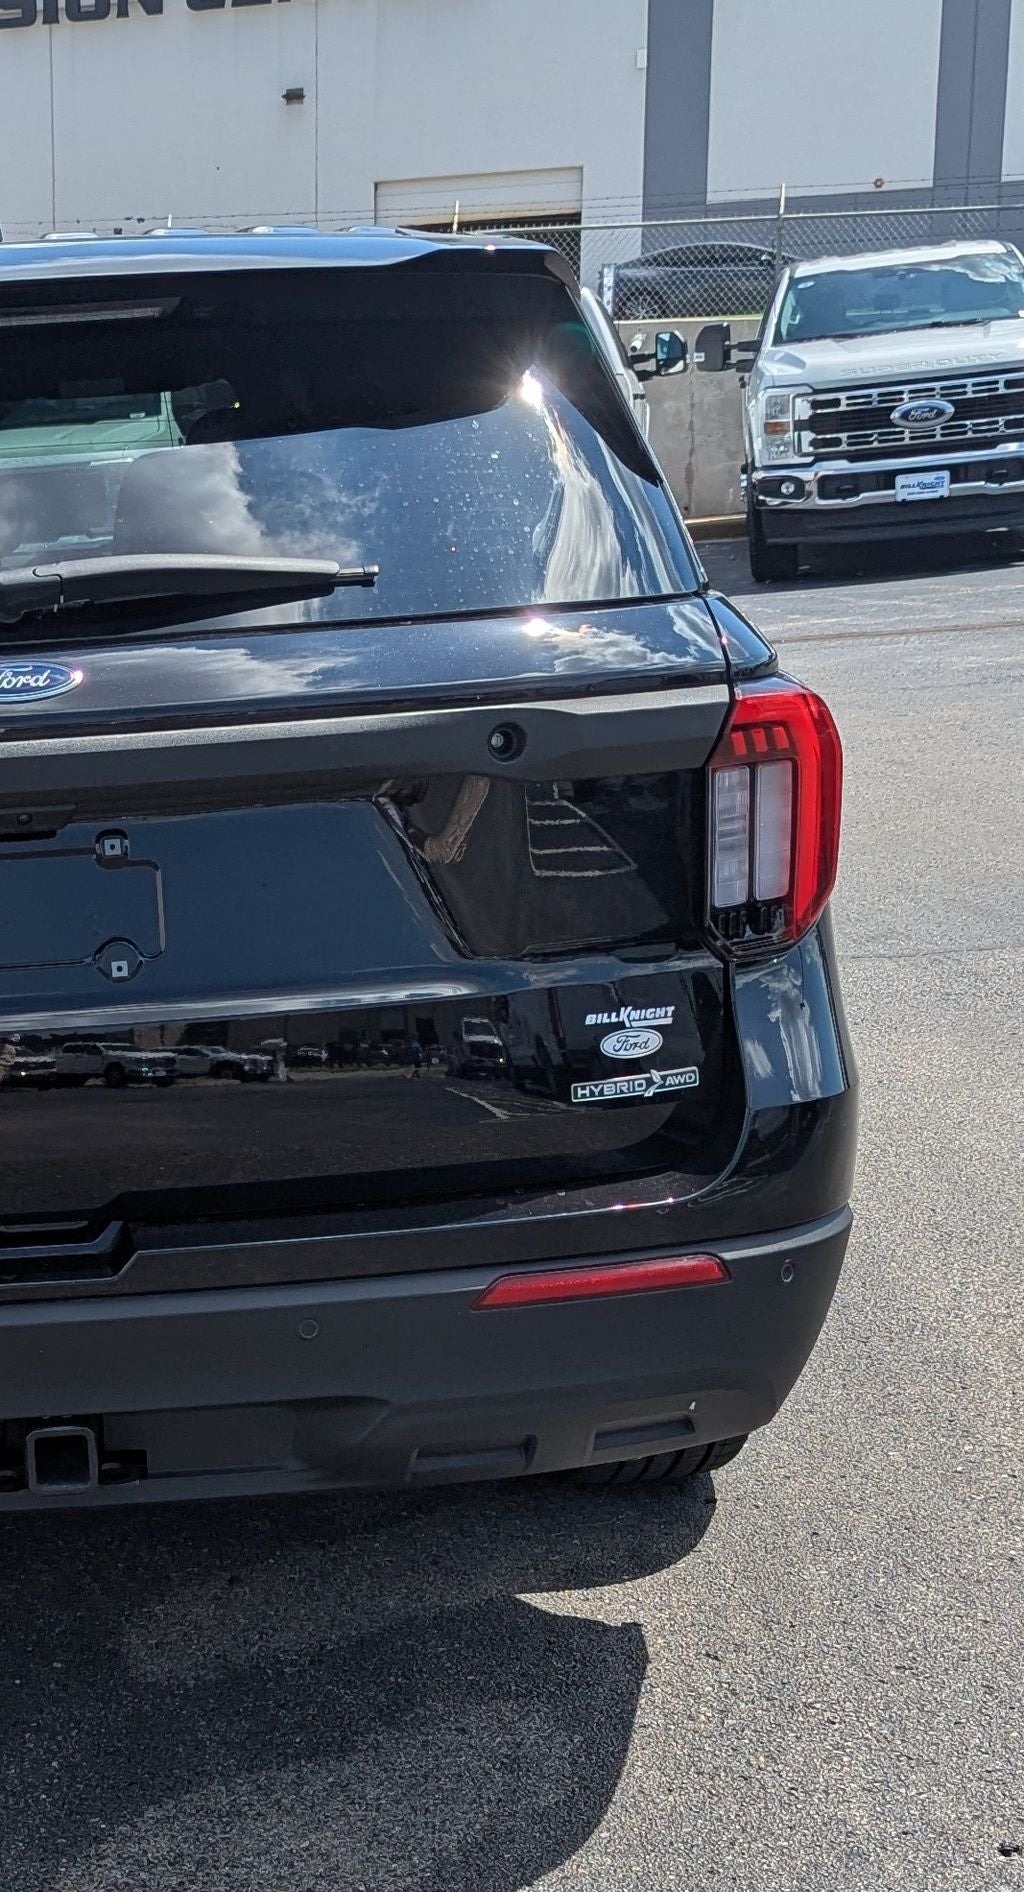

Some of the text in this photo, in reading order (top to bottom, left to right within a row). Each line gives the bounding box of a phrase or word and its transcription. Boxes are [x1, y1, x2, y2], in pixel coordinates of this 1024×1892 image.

[613, 1035, 650, 1052] Ford
[577, 1072, 695, 1099] HYBRID AWD
